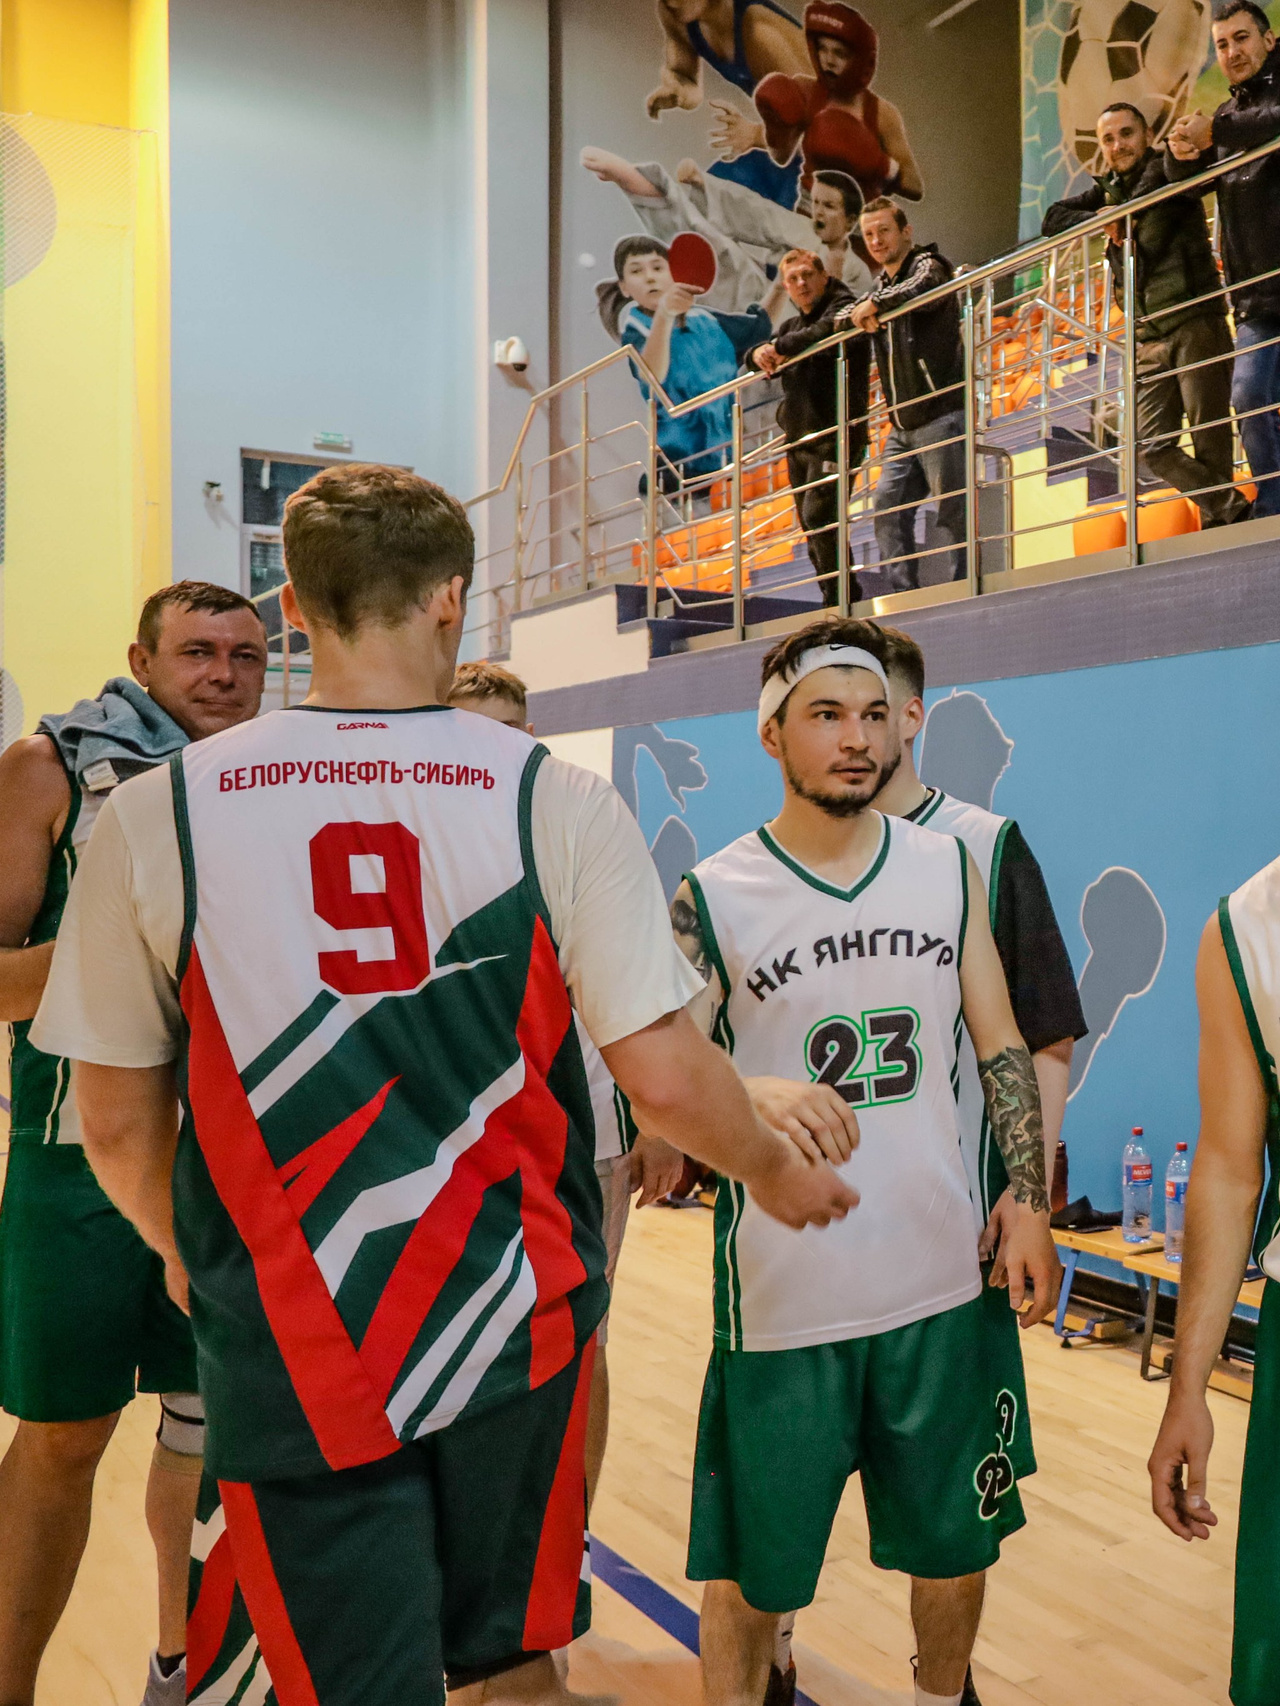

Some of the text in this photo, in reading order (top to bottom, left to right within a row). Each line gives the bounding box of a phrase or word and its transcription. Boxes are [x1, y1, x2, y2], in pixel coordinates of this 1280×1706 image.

[336, 722, 390, 731] GARNA
[219, 760, 495, 793] БЕЛОРУСНЕФТЬ-СИБИРЬ
[309, 821, 430, 995] 9
[747, 927, 955, 1002] НК ЯНГПУР
[805, 1007, 922, 1109] 23
